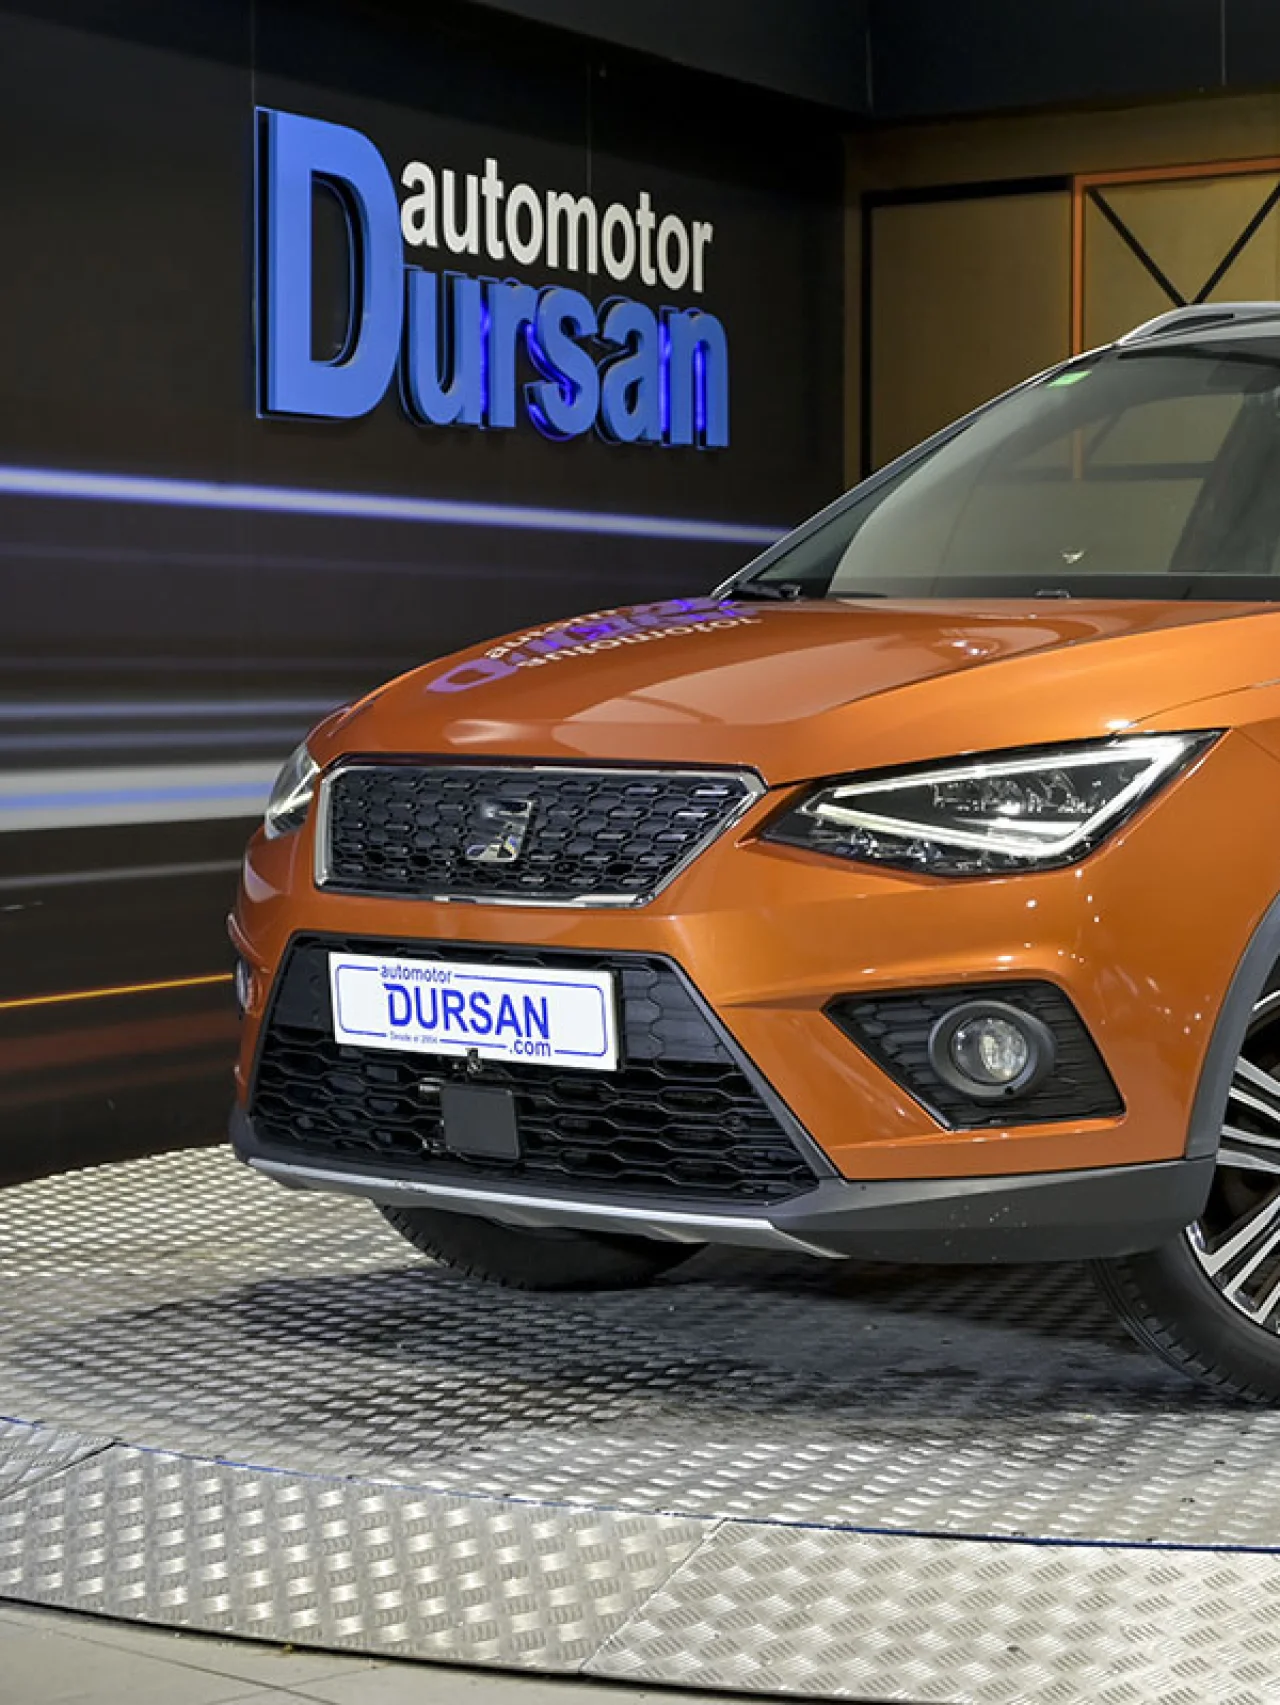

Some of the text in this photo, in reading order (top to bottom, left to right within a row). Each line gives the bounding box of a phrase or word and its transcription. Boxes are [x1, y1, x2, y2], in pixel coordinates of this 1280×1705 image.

[400, 157, 714, 293] automotor
[255, 106, 730, 448] Dursan
[381, 965, 452, 983] automotor
[383, 984, 549, 1038] DURSAN
[509, 1038, 552, 1057] .com
